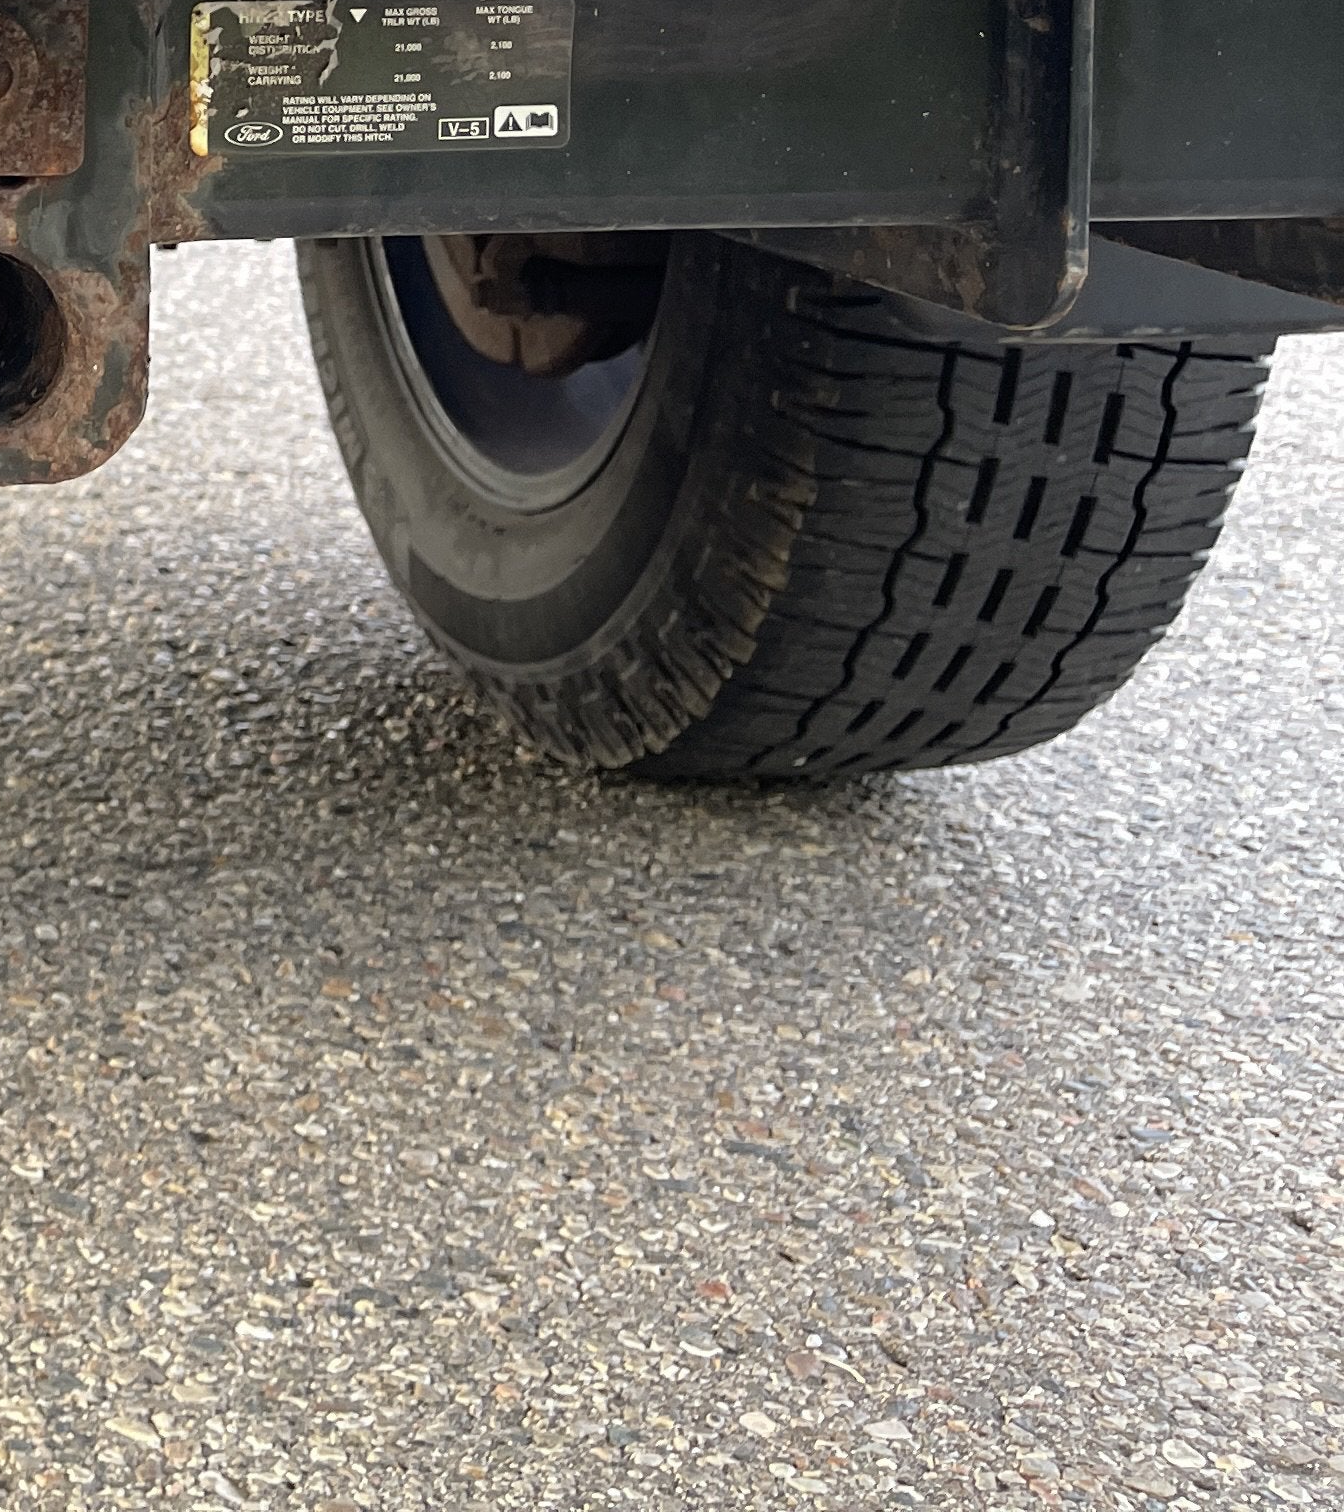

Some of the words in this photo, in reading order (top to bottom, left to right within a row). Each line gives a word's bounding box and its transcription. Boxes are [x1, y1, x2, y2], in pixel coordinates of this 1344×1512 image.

[385, 7, 404, 17] MAX
[406, 6, 438, 17] GROSS
[475, 5, 494, 15] MAX
[497, 4, 534, 14] TONGUE
[287, 9, 325, 23] TYPE
[488, 15, 502, 24] WT
[502, 15, 521, 25] (LB)
[382, 17, 405, 27] TRLR
[407, 17, 421, 26] WT
[422, 17, 440, 27] (LB)
[248, 34, 290, 45] WEIGHT
[490, 40, 513, 50] 2,100
[248, 64, 290, 76] WEIGHT
[488, 70, 512, 80] 2,100
[247, 75, 302, 86] CARRYING
[282, 95, 315, 105] RATING
[317, 95, 339, 104] WILL
[340, 94, 363, 104] VARY
[365, 93, 416, 103] DEPENDING
[417, 93, 432, 102] ON
[282, 105, 320, 115] VEHICLE
[376, 104, 394, 113] SEE
[395, 102, 437, 112] OWNER'S
[282, 115, 320, 124] MANUAL
[322, 114, 340, 124] FOR
[342, 113, 382, 123] SPECIFIC
[383, 112, 418, 122] RATING.
[292, 125, 306, 134] DO
[308, 124, 326, 134] NOT
[379, 122, 405, 132] WELD
[237, 125, 272, 143] Ford
[292, 134, 306, 143] OR
[307, 134, 341, 144] MODIFY
[343, 133, 363, 143] THIS
[364, 133, 394, 142] HITCH.
